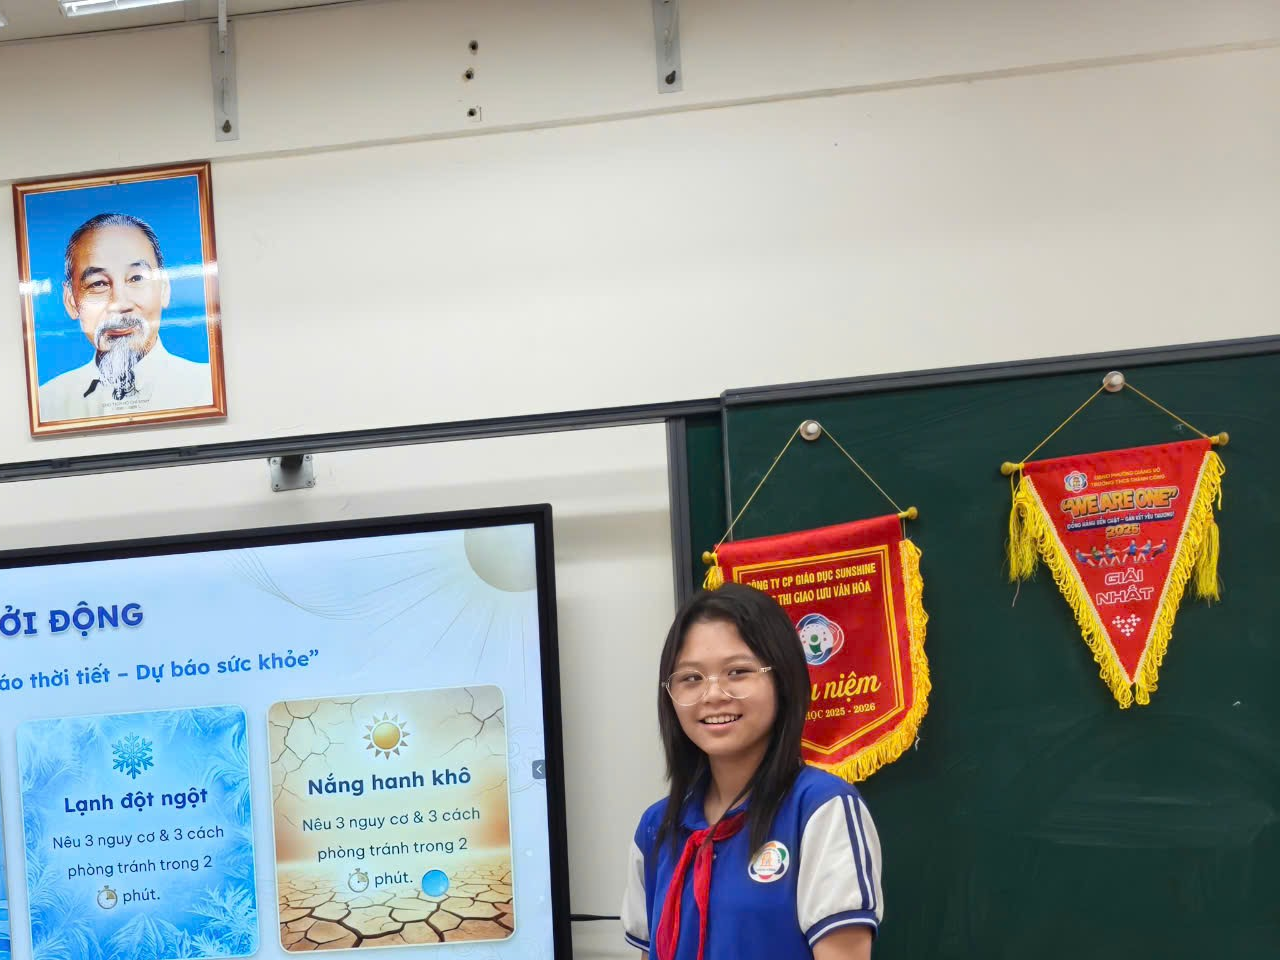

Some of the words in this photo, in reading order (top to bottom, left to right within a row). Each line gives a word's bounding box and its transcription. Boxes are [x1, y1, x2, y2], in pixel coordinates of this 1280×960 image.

[1100, 489, 1134, 512] ARE
[770, 578, 779, 589] TY
[782, 575, 793, 587] CP
[795, 571, 815, 585] GIÁO
[817, 571, 833, 583] DỤC
[835, 562, 876, 578] SUNSHINE
[1105, 567, 1143, 585] GIẢI
[778, 593, 792, 605] THI
[794, 590, 815, 603] GIAO
[833, 585, 851, 597] VĂN
[852, 579, 871, 593] HÓA
[1096, 584, 1154, 605] NHẤT
[48, 601, 143, 636] ĐỘNG
[30, 668, 69, 688] thời
[76, 663, 110, 684] tiết
[136, 664, 164, 682] Dự
[171, 659, 210, 677] báo
[217, 655, 252, 673] sức
[823, 671, 881, 702] niệm
[825, 707, 845, 718] 2025
[853, 702, 875, 714] 2026
[308, 772, 364, 796] Nắng
[372, 771, 425, 790] hanh
[432, 766, 471, 786] khô
[64, 794, 113, 816] Lạnh
[120, 790, 154, 812] đột
[161, 787, 208, 809] ngột
[302, 817, 331, 831] Nêu
[336, 816, 345, 829] 3
[349, 815, 385, 831] nguy
[390, 813, 409, 825] cơ
[413, 810, 424, 823] &
[428, 809, 438, 822] 3
[442, 807, 480, 821] cách
[52, 835, 81, 849] Nêu
[85, 834, 94, 847] 3
[98, 833, 133, 848] nguy
[137, 831, 155, 843] cơ
[159, 829, 170, 841] &
[174, 828, 183, 840] 3
[187, 825, 224, 840] cách
[318, 845, 365, 862] phòng
[369, 842, 409, 856] tránh
[413, 840, 454, 853] trong
[458, 837, 468, 850] 2
[68, 863, 114, 879] phòng
[117, 859, 156, 874] tránh
[159, 858, 199, 872] trong
[203, 855, 213, 868] 2
[375, 870, 413, 888] phút.
[122, 887, 160, 904] phút.
